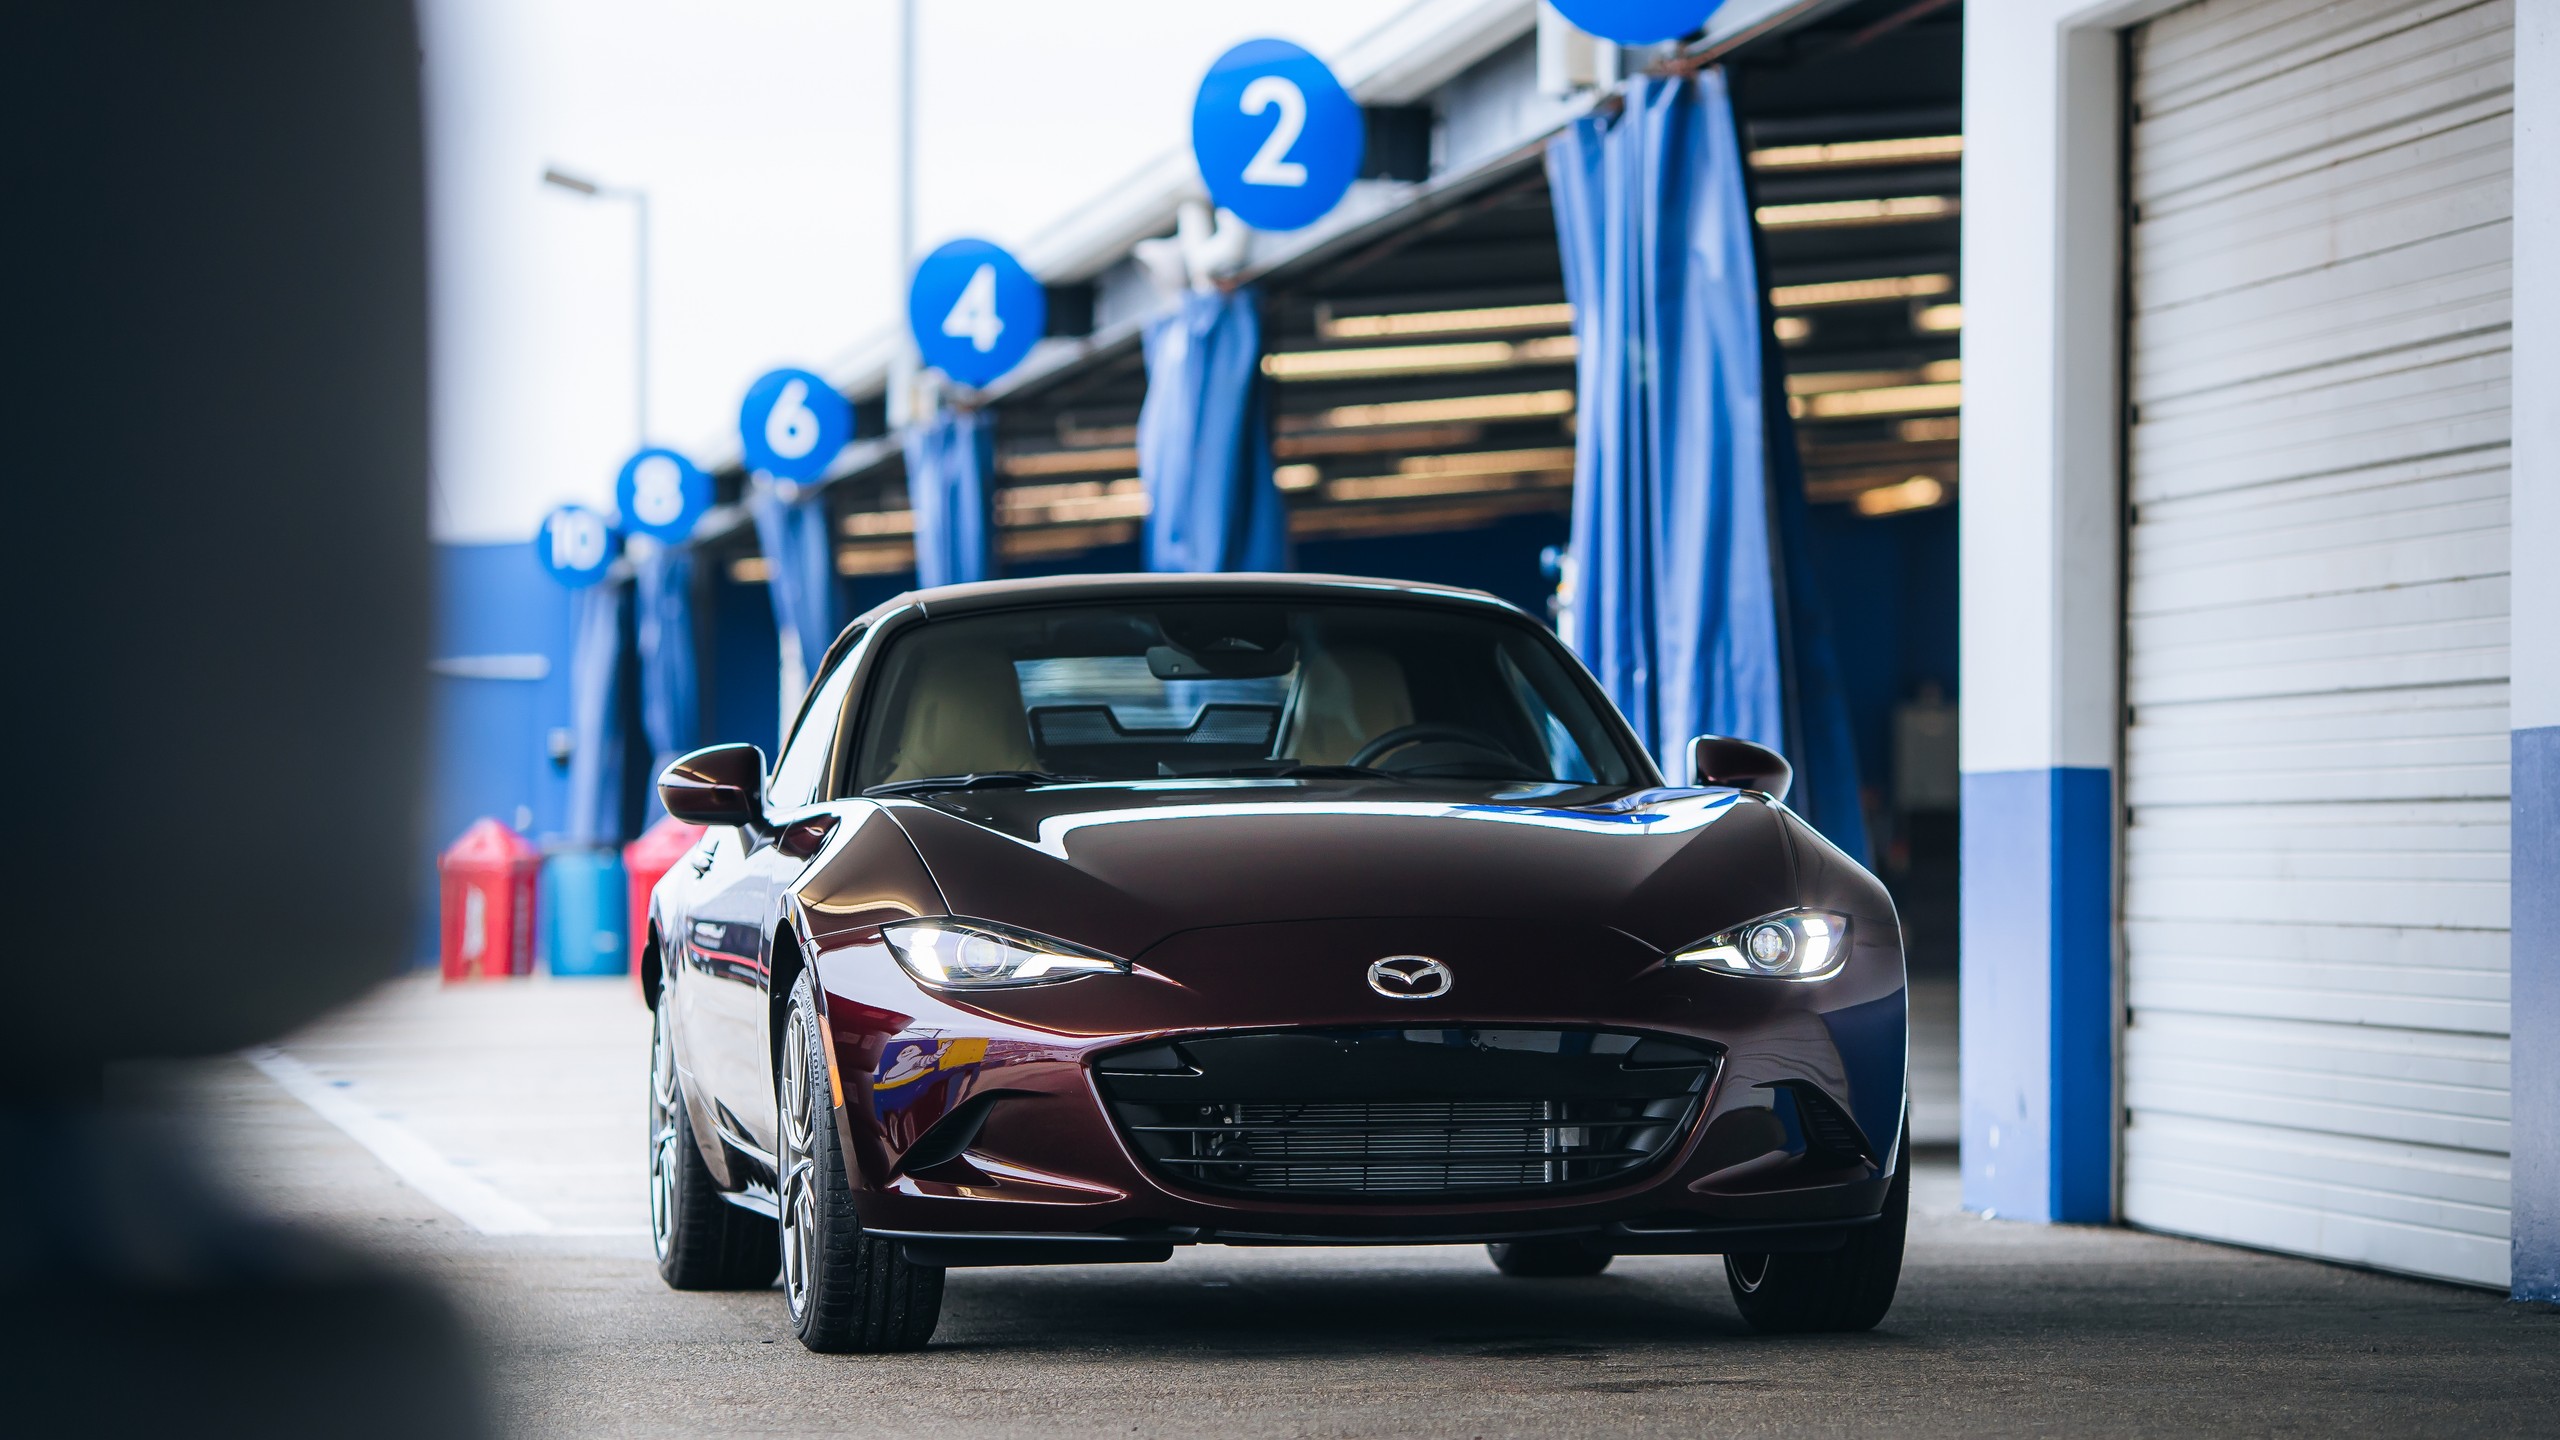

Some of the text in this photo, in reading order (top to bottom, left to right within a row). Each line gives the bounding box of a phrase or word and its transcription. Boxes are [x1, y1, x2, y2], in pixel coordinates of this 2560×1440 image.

[1241, 76, 1306, 185] 2
[943, 265, 1003, 351] 4
[766, 380, 818, 458] 6
[634, 456, 682, 525] 8
[546, 508, 606, 570] 10
